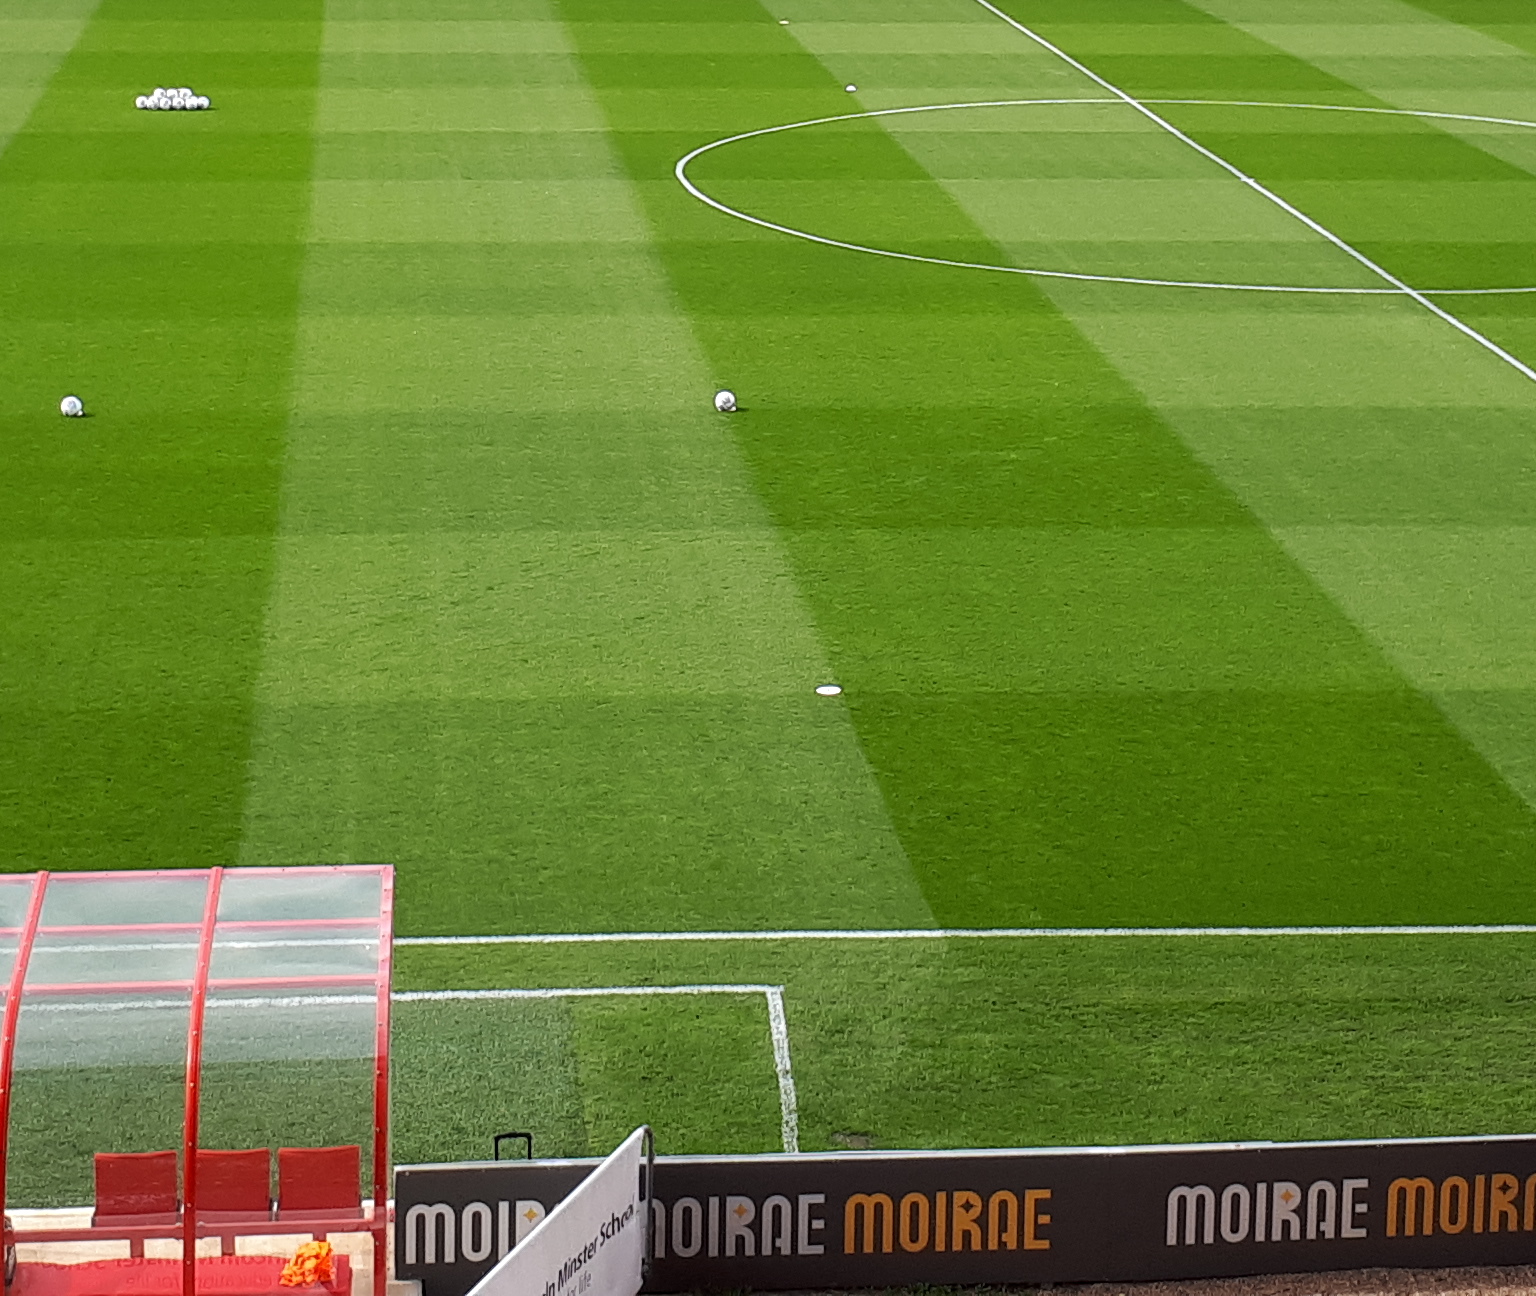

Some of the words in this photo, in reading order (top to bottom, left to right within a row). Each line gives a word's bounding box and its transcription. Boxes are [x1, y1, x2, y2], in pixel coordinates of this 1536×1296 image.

[843, 1188, 1054, 1256] MOIRAE
[1165, 1178, 1369, 1247] MOIRAE
[558, 1236, 598, 1292] Minster
